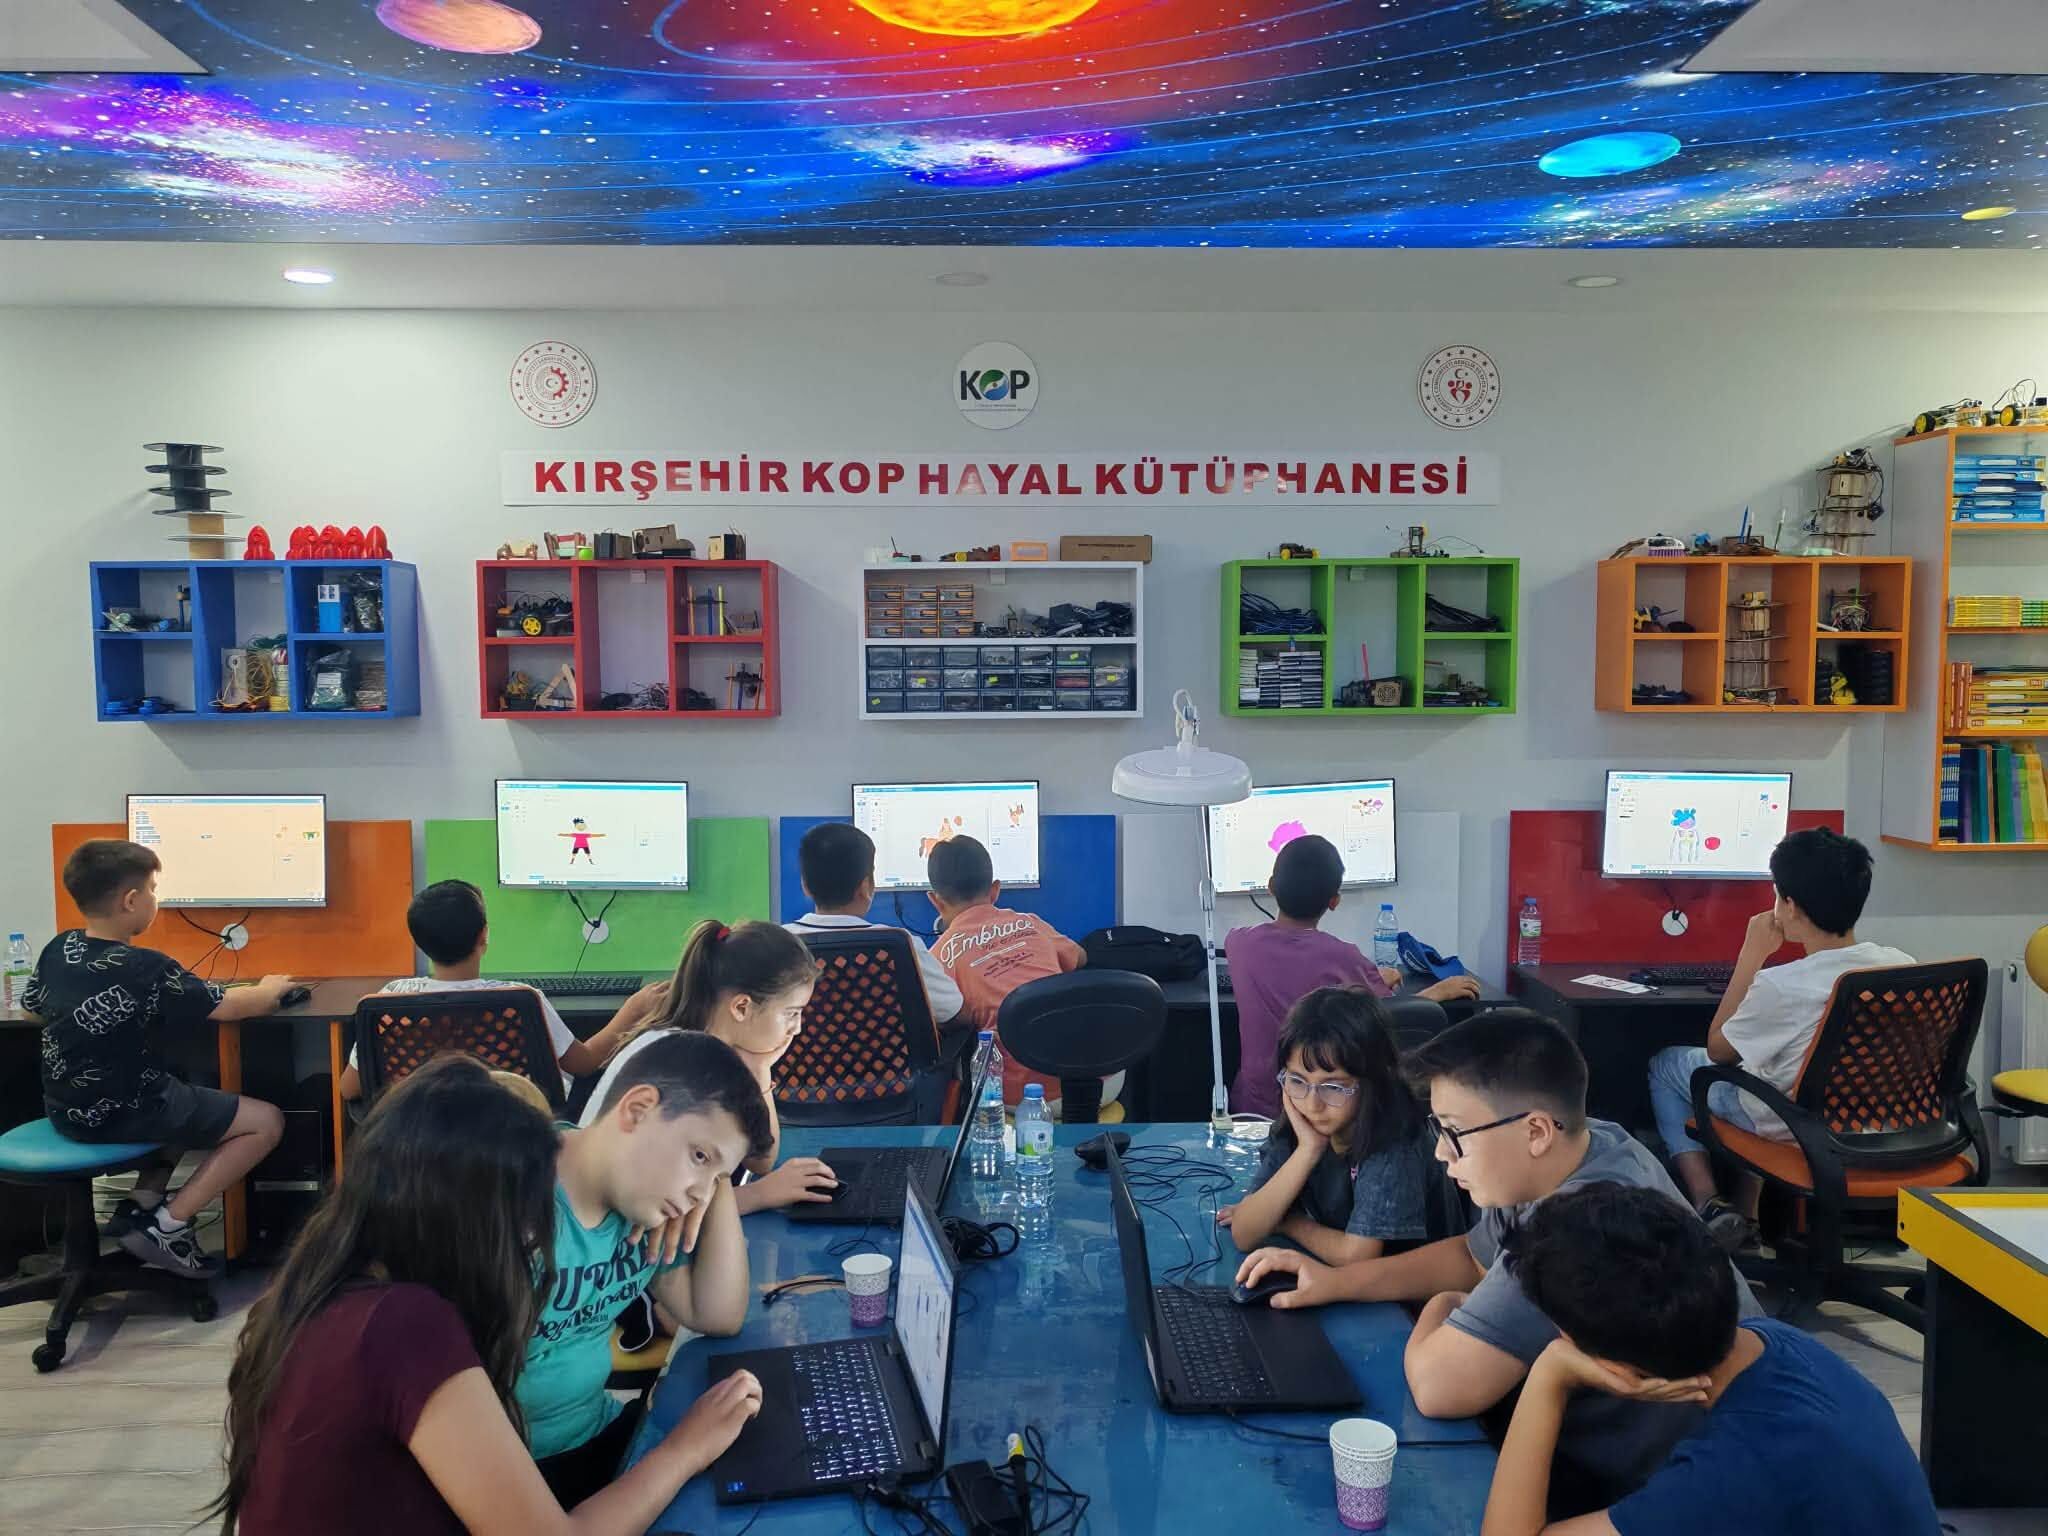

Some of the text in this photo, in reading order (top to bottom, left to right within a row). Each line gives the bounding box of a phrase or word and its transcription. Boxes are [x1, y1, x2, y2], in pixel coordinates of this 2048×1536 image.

[960, 369, 1030, 401] KOP
[534, 454, 1468, 502] KIRŞEHİR KOP HAYAL KÜTÜPHANESİ
[940, 919, 1035, 969] Embrace
